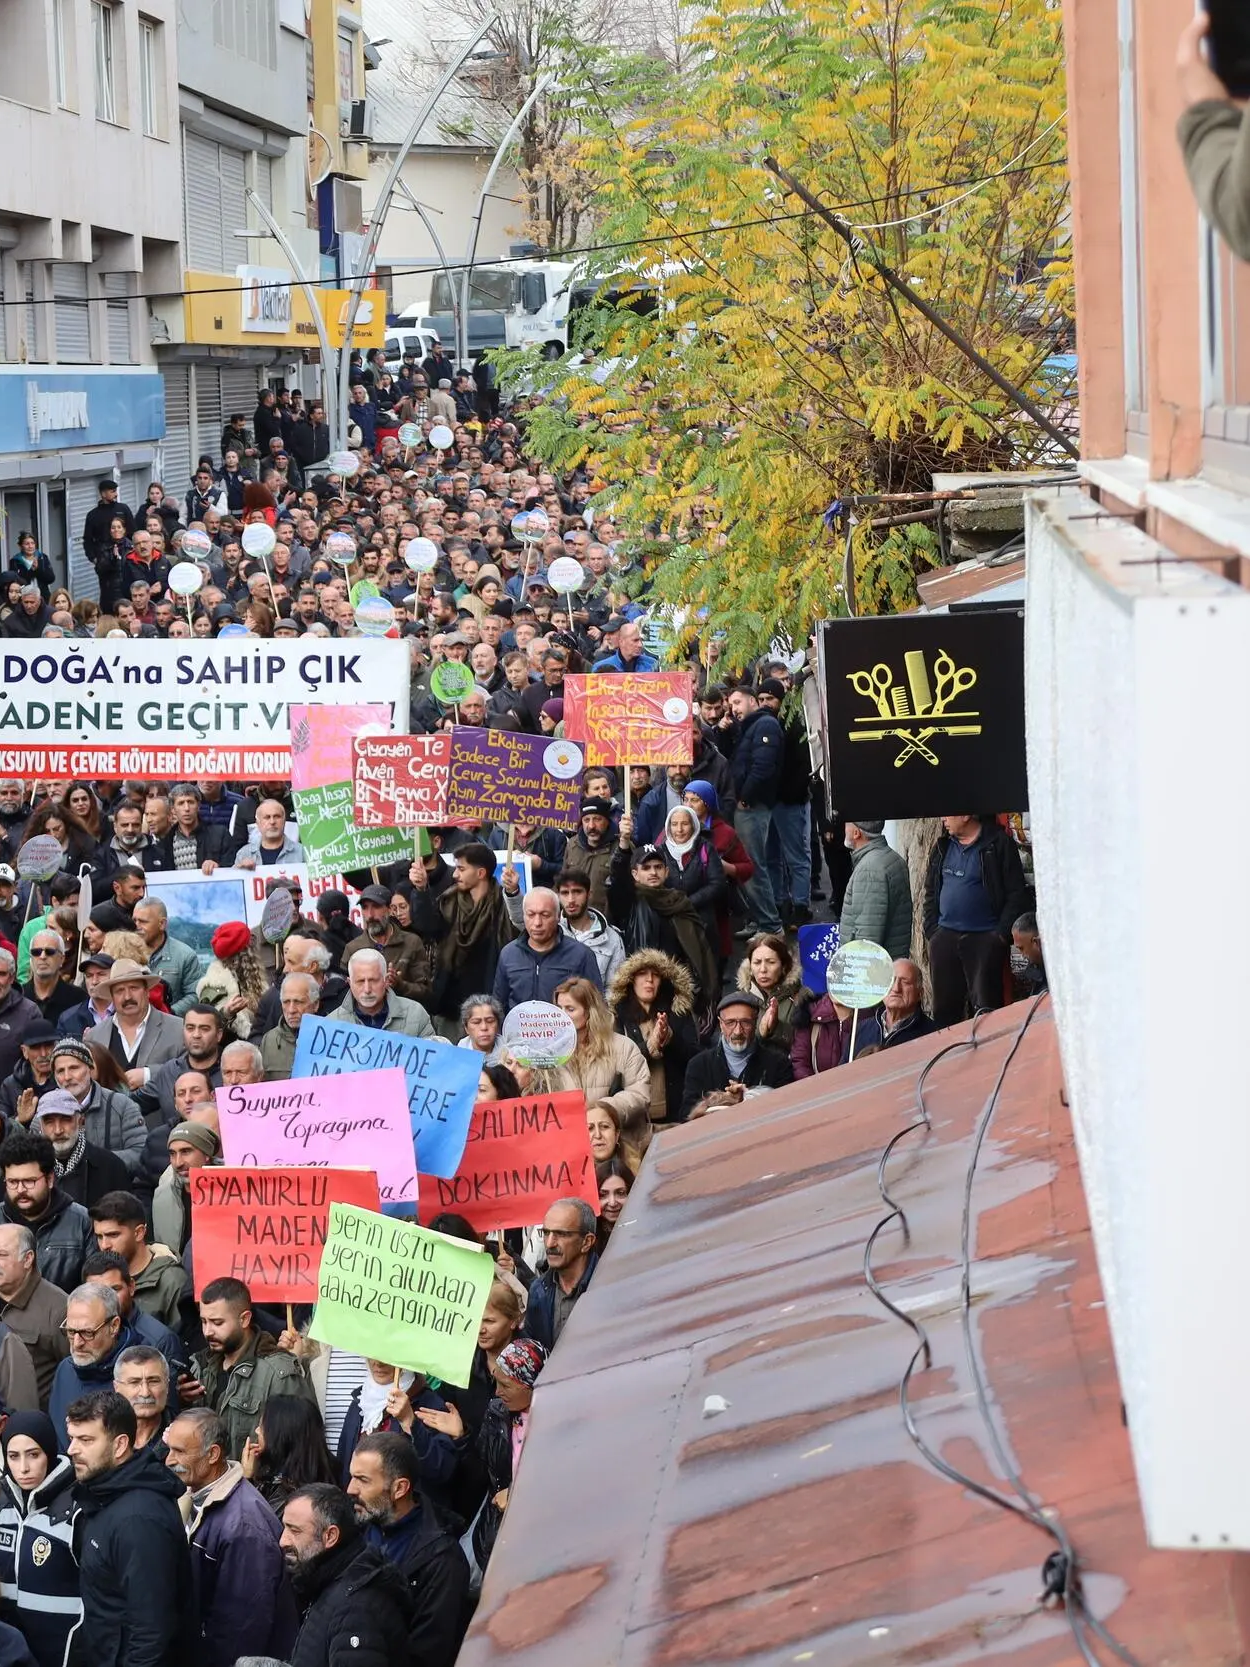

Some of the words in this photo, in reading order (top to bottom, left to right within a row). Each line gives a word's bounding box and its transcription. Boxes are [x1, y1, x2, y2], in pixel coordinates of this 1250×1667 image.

[177, 648, 286, 685] SAHİP
[298, 655, 362, 692] ÇIK
[138, 694, 248, 740] GEÇİT
[417, 736, 444, 756] Te
[450, 743, 501, 766] Sadece
[48, 752, 68, 773] VE
[70, 752, 117, 778] ÇEVRE
[119, 747, 180, 775] KÖYLERİ
[183, 747, 240, 774] DOĞAYI
[495, 768, 539, 789] Sorunu
[478, 783, 552, 808] Zamanda
[521, 1030, 557, 1038] HAYIR!
[192, 1175, 329, 1207] SİYANÜRLÜ
[237, 1215, 328, 1247] MADEN
[230, 1253, 315, 1287] HAYIR
